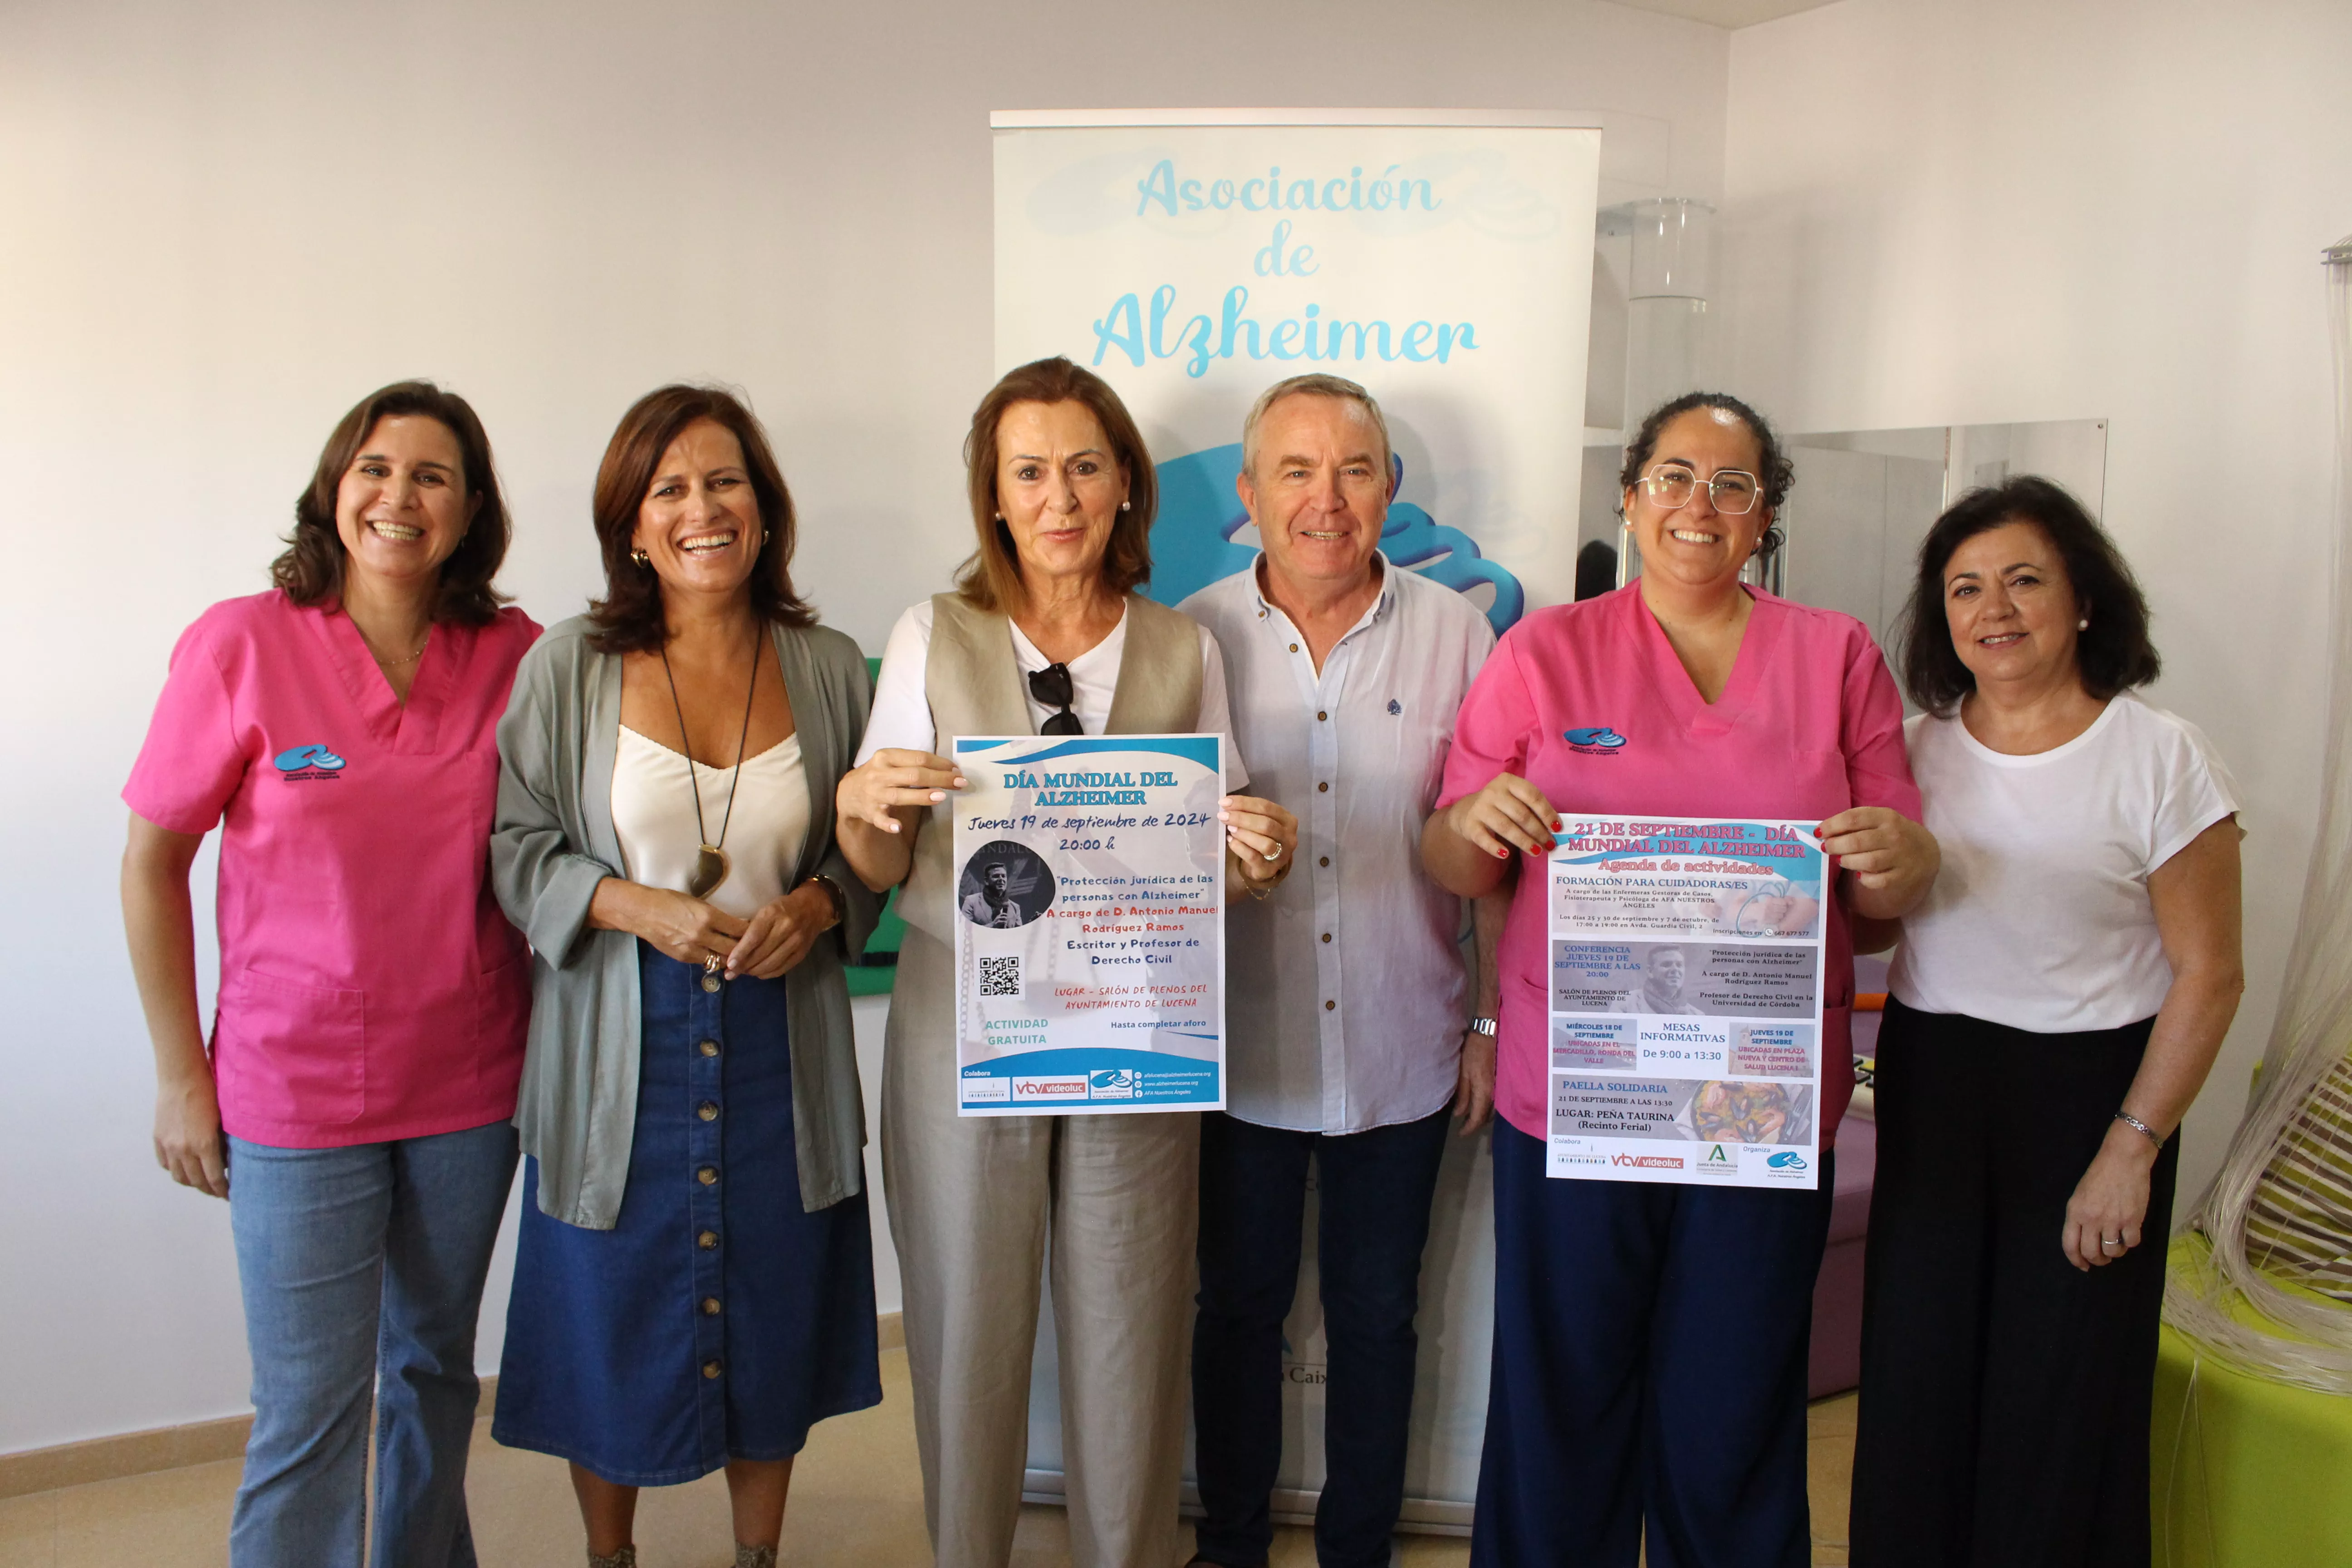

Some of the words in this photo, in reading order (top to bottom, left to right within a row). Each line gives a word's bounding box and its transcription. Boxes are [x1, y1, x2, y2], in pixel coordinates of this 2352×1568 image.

[1137, 159, 1442, 217] Asociación
[1254, 219, 1321, 277] de
[1092, 284, 1480, 378] Alzheimer
[1004, 769, 1039, 788] DÍA
[1044, 772, 1136, 788] MUNDIAL
[1140, 772, 1178, 786] DEL
[1034, 790, 1147, 806] ALZHEIMER
[968, 817, 1015, 830] Jueves
[1020, 815, 1036, 829] 19
[1042, 817, 1058, 828] de
[1062, 813, 1136, 833] septiembre
[1142, 815, 1158, 827] de
[1165, 813, 1211, 828] 2024
[1575, 823, 1594, 835] 21
[1600, 822, 1625, 835] DE
[1629, 823, 1744, 839] SEPTIEMBRE
[1765, 825, 1799, 841] DÍA
[1059, 839, 1100, 850] 20:00
[1105, 836, 1115, 849] h
[1568, 838, 1654, 853] MUNDIAL
[1658, 840, 1694, 853] DEL
[1699, 841, 1806, 858] ALZHEIMER
[1598, 858, 1657, 873] Agenda
[1661, 859, 1680, 871] de
[1684, 861, 1774, 875] actividades
[1130, 876, 1175, 886] jurídica
[1556, 876, 1622, 886] FORMACIÓN
[1626, 878, 1655, 887] PARA
[1658, 878, 1748, 889] CUIDADORAS/ES
[1063, 892, 1113, 903] personas
[1046, 909, 1054, 918] A
[1059, 909, 1091, 919] cargo
[1113, 907, 1125, 916] D.
[1130, 907, 1174, 916] Antonio
[1178, 906, 1218, 915] Manuel
[1083, 924, 1142, 934] Rodríguez
[1147, 923, 1184, 931] Ramos
[1067, 940, 1116, 949] Escritor
[1131, 939, 1181, 947] Profesor
[1186, 938, 1199, 946] de
[1092, 956, 1141, 965] Derecho
[1145, 955, 1172, 963] Civil
[1055, 988, 1085, 996] LUGAR
[1099, 985, 1129, 995] SALÓN
[1149, 985, 1186, 994] PLENOS
[1191, 985, 1207, 993] DEL
[1066, 1000, 1140, 1009] AYUNTAMIENTO
[1162, 999, 1197, 1007] LUCENA
[985, 1019, 1048, 1029] ACTIVIDAD
[1138, 1020, 1181, 1029] completar
[1663, 1023, 1700, 1032] MESAS
[988, 1035, 1046, 1045] GRATUITA
[1640, 1032, 1725, 1043] INFORMATIVAS
[1643, 1049, 1657, 1058] De
[1660, 1050, 1681, 1058] 9:00
[1694, 1052, 1721, 1060] 13:30
[1046, 1084, 1083, 1093] videoluc
[1563, 1081, 1604, 1090] PAELLA
[1607, 1083, 1668, 1093] SOLIDARIA
[1556, 1109, 1594, 1118] LUGAR:
[1597, 1109, 1624, 1119] PEÑA
[1627, 1112, 1675, 1122] TAURINA
[1578, 1121, 1617, 1130] (Recinto
[1621, 1122, 1651, 1132] Ferial)
[1642, 1159, 1681, 1167] videoluc
